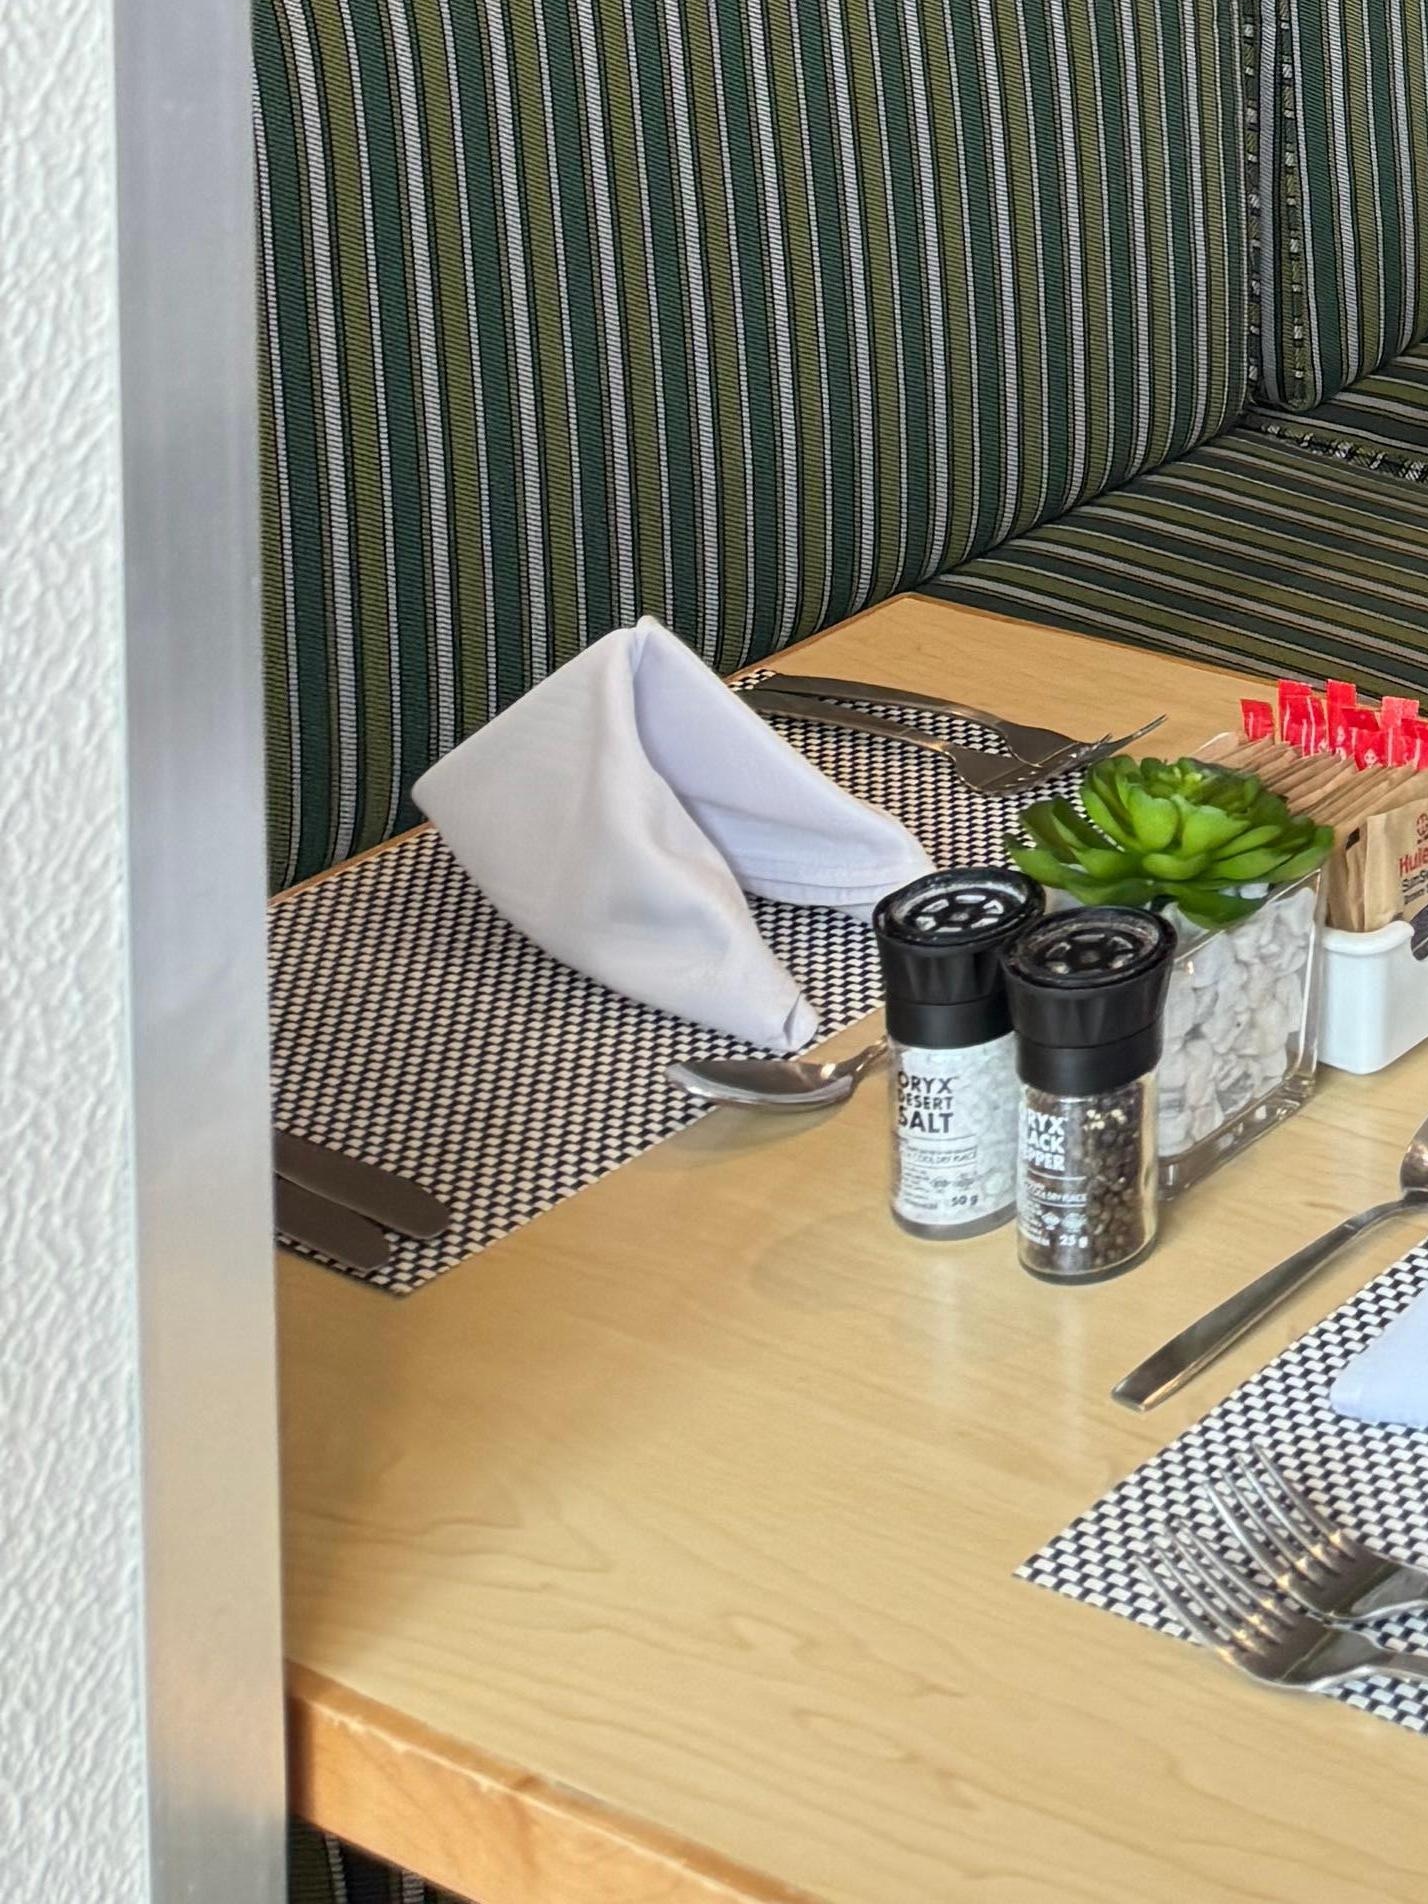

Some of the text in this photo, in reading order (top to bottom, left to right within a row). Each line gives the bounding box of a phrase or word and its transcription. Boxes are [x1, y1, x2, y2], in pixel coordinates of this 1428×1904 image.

[898, 1071, 952, 1094] ORYX
[898, 1106, 954, 1133] SALT
[1019, 1107, 1065, 1135] RYX
[1022, 1130, 1065, 1154] ACK
